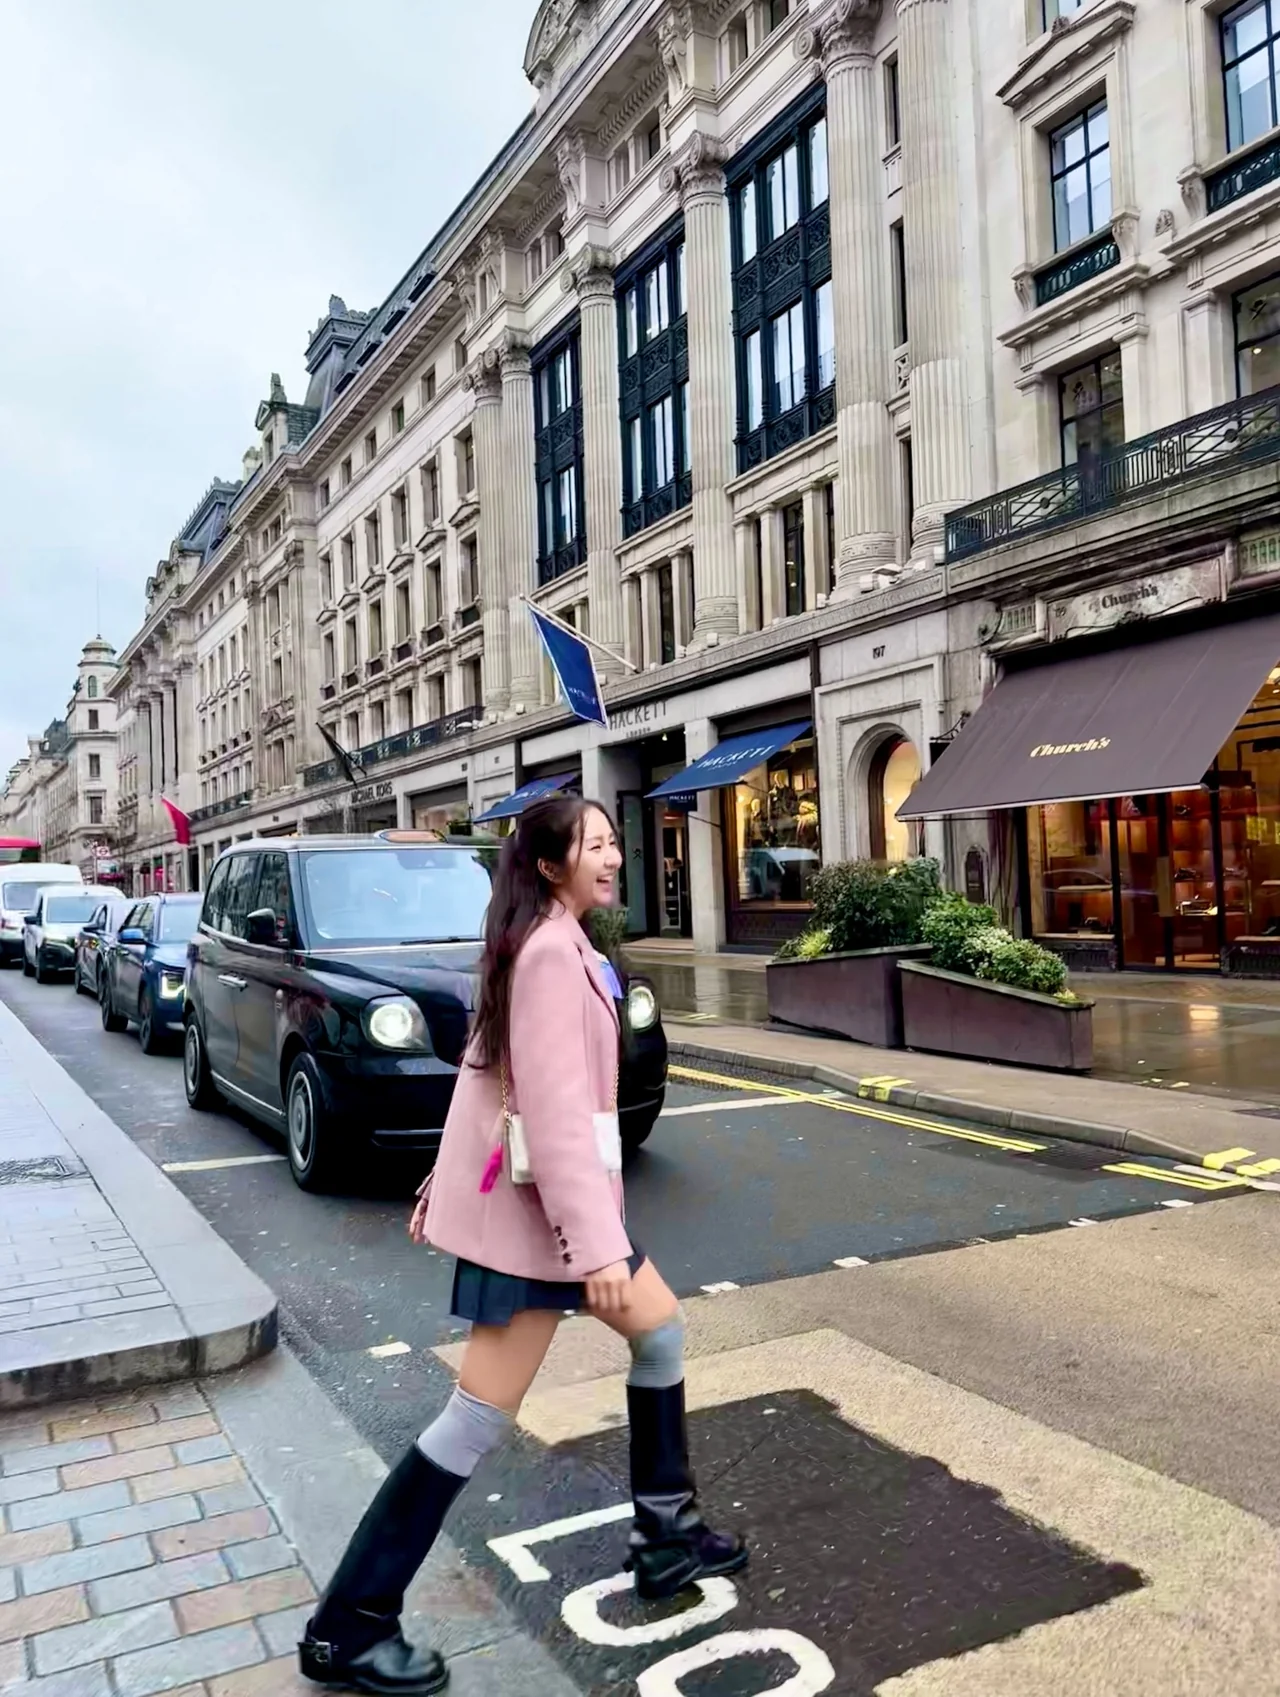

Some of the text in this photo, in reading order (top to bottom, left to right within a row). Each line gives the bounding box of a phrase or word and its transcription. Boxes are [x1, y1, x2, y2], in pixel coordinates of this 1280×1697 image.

[1101, 584, 1158, 609] Church's
[609, 700, 668, 731] HACKETT
[697, 745, 775, 769] HACKETT
[1030, 737, 1111, 758] Church's
